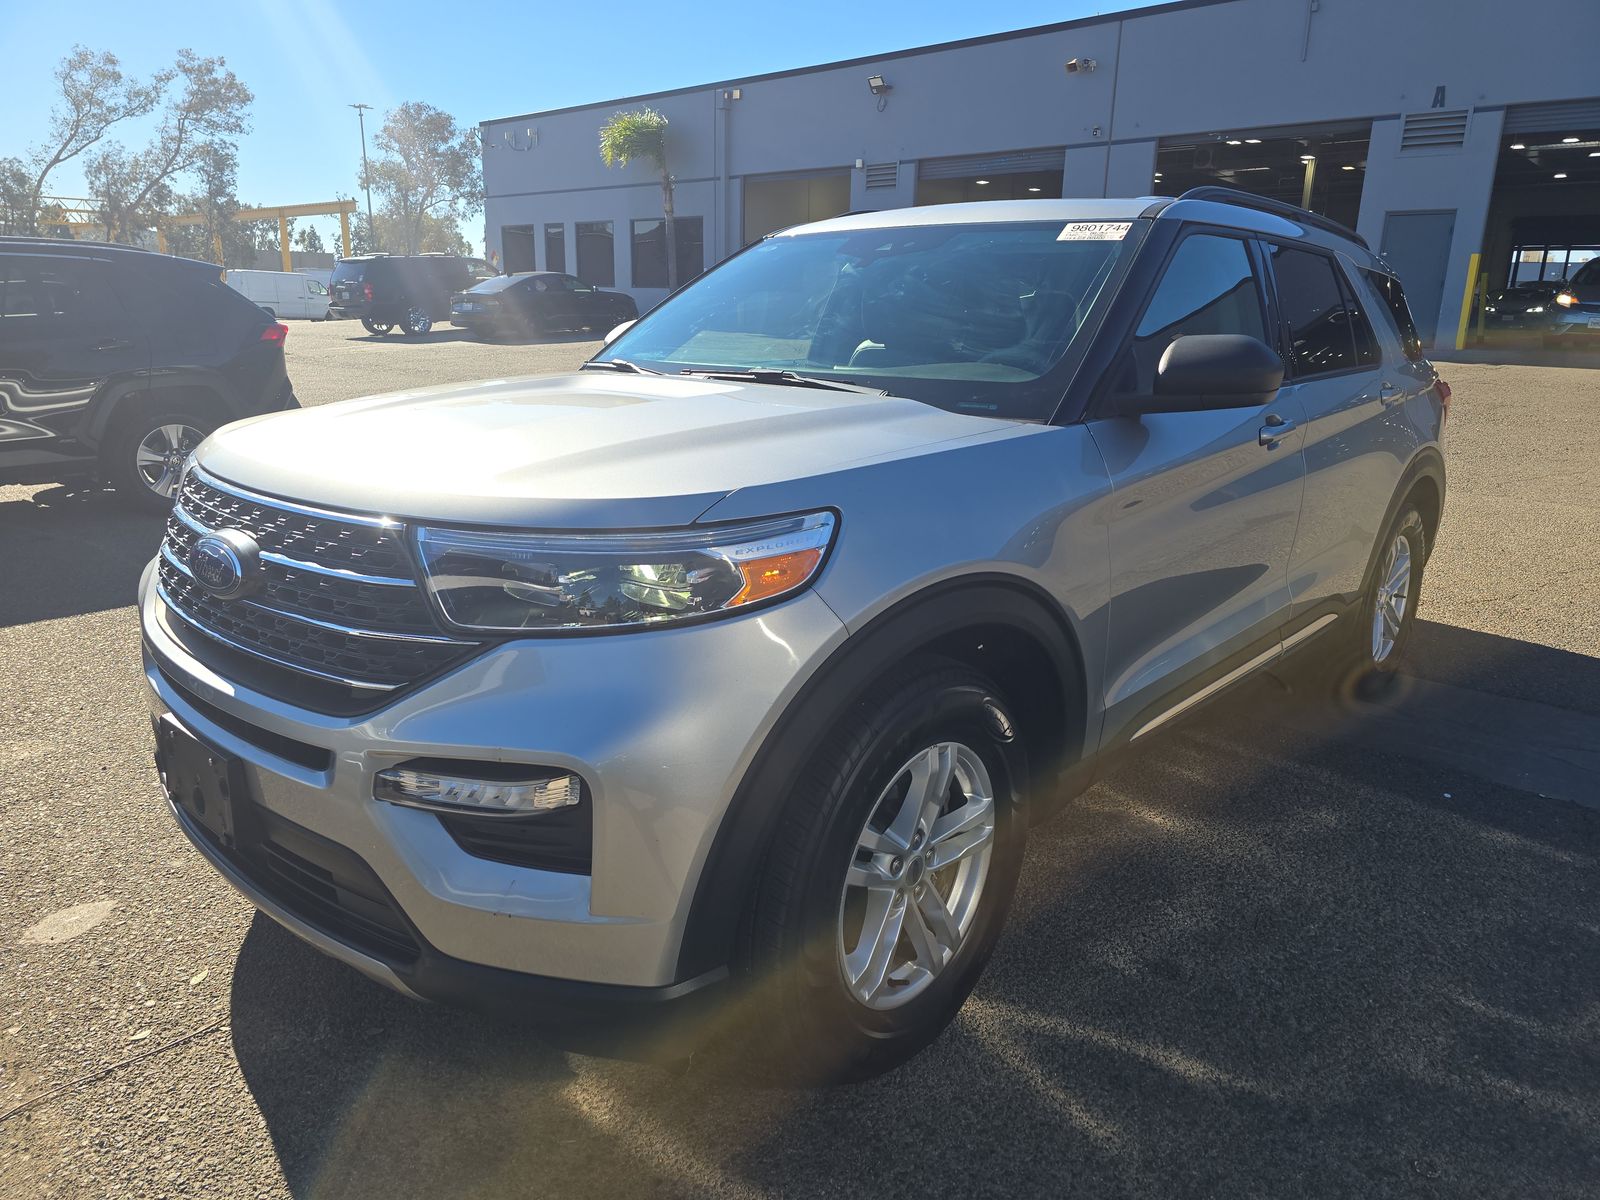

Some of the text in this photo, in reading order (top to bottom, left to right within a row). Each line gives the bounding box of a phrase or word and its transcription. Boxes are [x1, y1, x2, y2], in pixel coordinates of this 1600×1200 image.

[1431, 86, 1446, 108] A
[1070, 224, 1130, 232] 9801744
[735, 537, 814, 555] EXPLOR
